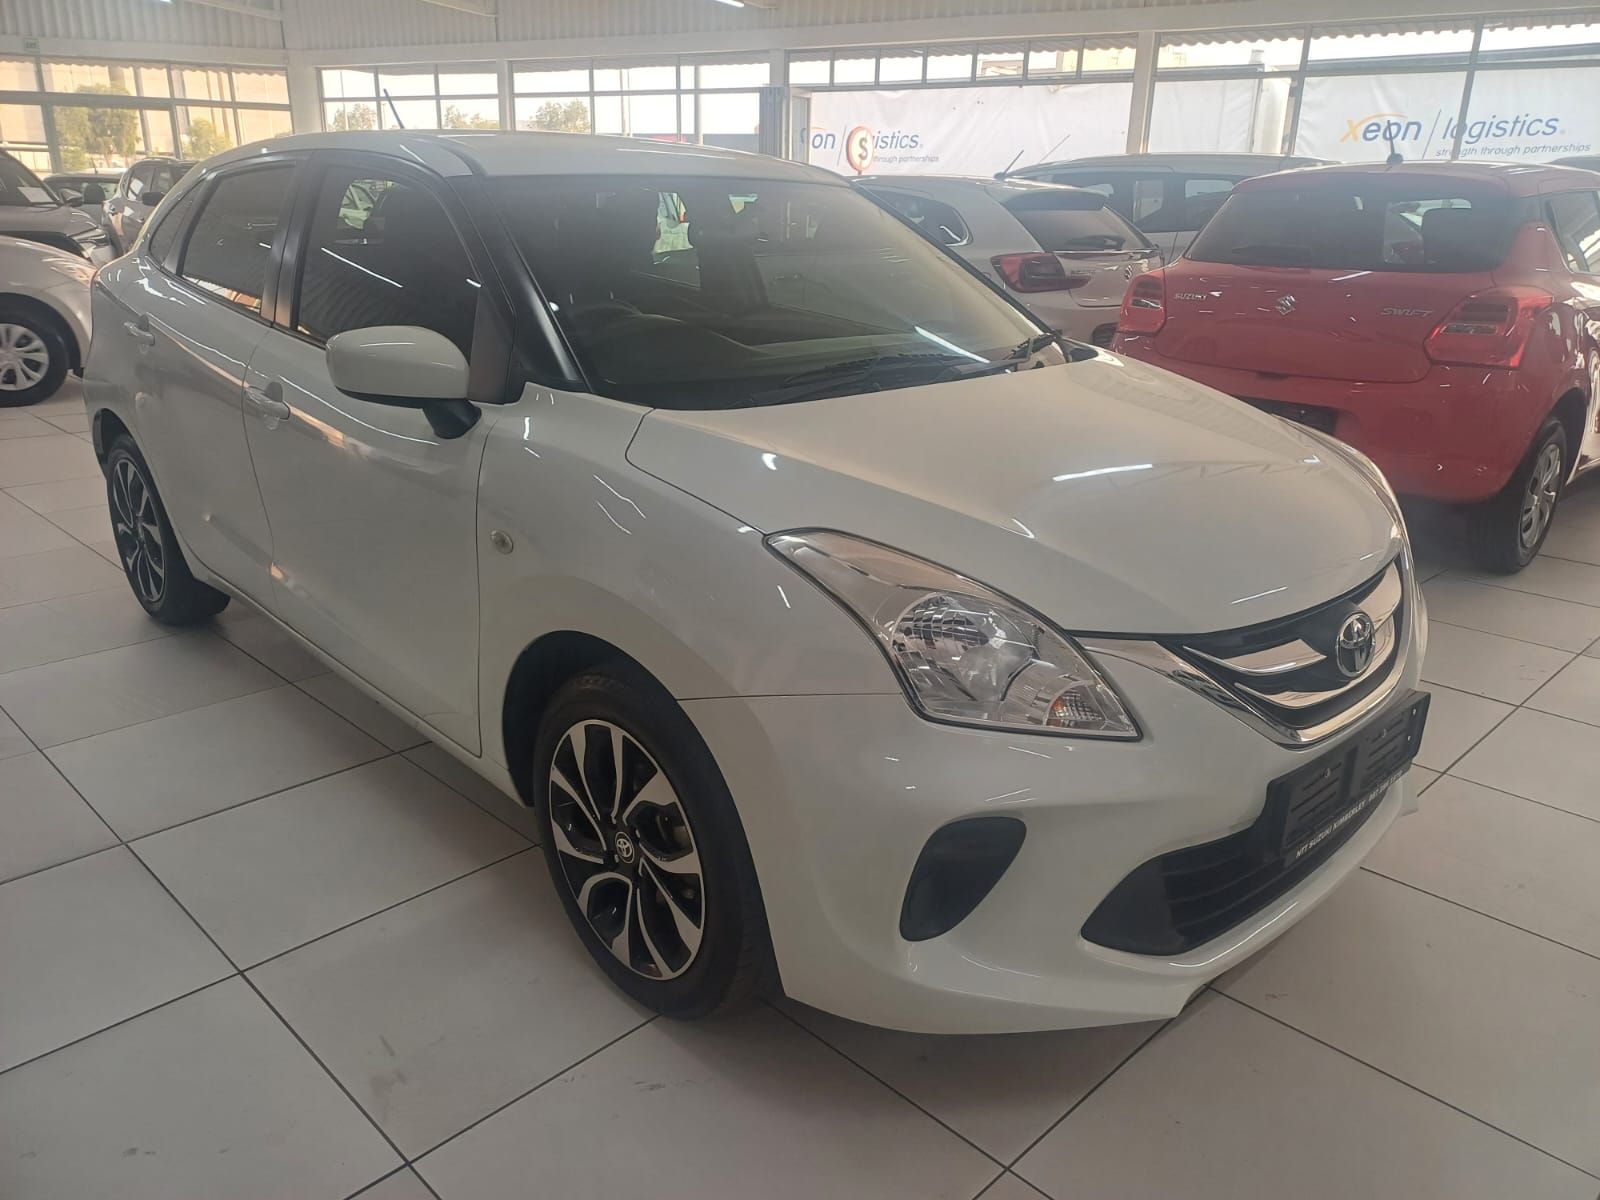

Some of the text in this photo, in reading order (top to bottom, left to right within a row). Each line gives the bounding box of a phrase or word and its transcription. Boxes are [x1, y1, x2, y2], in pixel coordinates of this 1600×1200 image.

[1339, 112, 1424, 144] xeon
[1480, 145, 1521, 157] through
[1522, 142, 1592, 156] partnerships
[898, 155, 939, 165] partnerships
[1380, 306, 1433, 318] SWIFT
[1308, 827, 1333, 849] SUZUKI
[1333, 801, 1366, 829] KIMBERLEY
